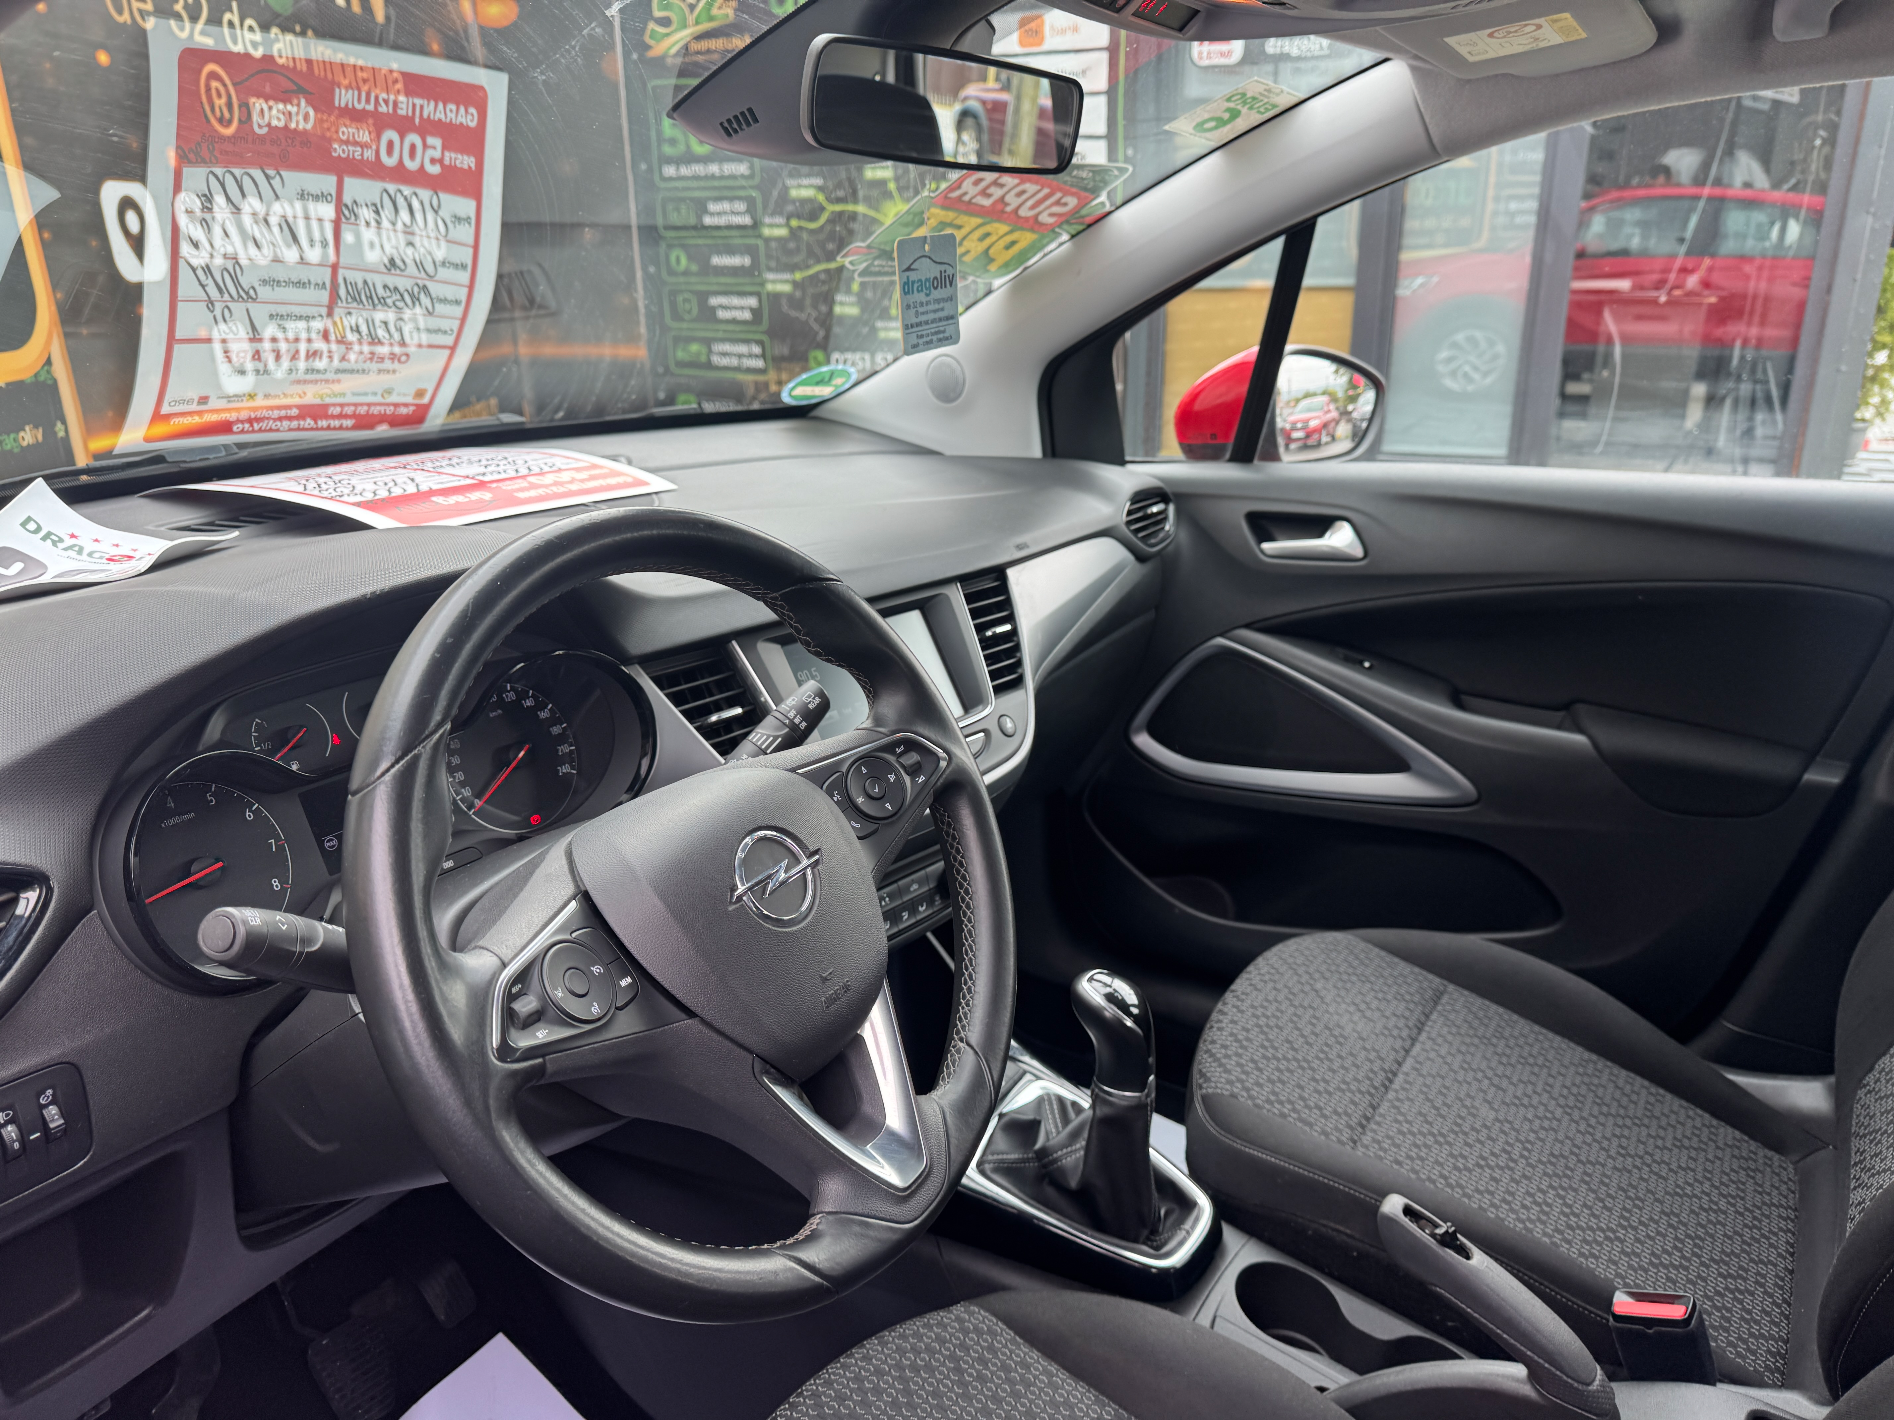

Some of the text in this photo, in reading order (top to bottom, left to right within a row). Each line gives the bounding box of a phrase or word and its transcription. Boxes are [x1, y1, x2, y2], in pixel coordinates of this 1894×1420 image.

[222, 1, 264, 58] de
[269, 24, 307, 72] ani
[902, 269, 955, 298] dragoliv
[503, 692, 516, 702] 120
[522, 697, 535, 708] 140
[537, 708, 550, 719] 160
[550, 726, 562, 735] 180
[557, 744, 569, 755] 210
[450, 755, 461, 765] 30
[557, 764, 571, 776] 240
[455, 771, 465, 782] 20
[461, 786, 472, 797] 10
[166, 797, 175, 809] 4
[206, 793, 216, 805] 5
[245, 808, 254, 820] 6
[268, 839, 276, 852] 7
[271, 878, 281, 891] 8
[248, 916, 261, 925] CLR
[619, 975, 632, 987] MEM
